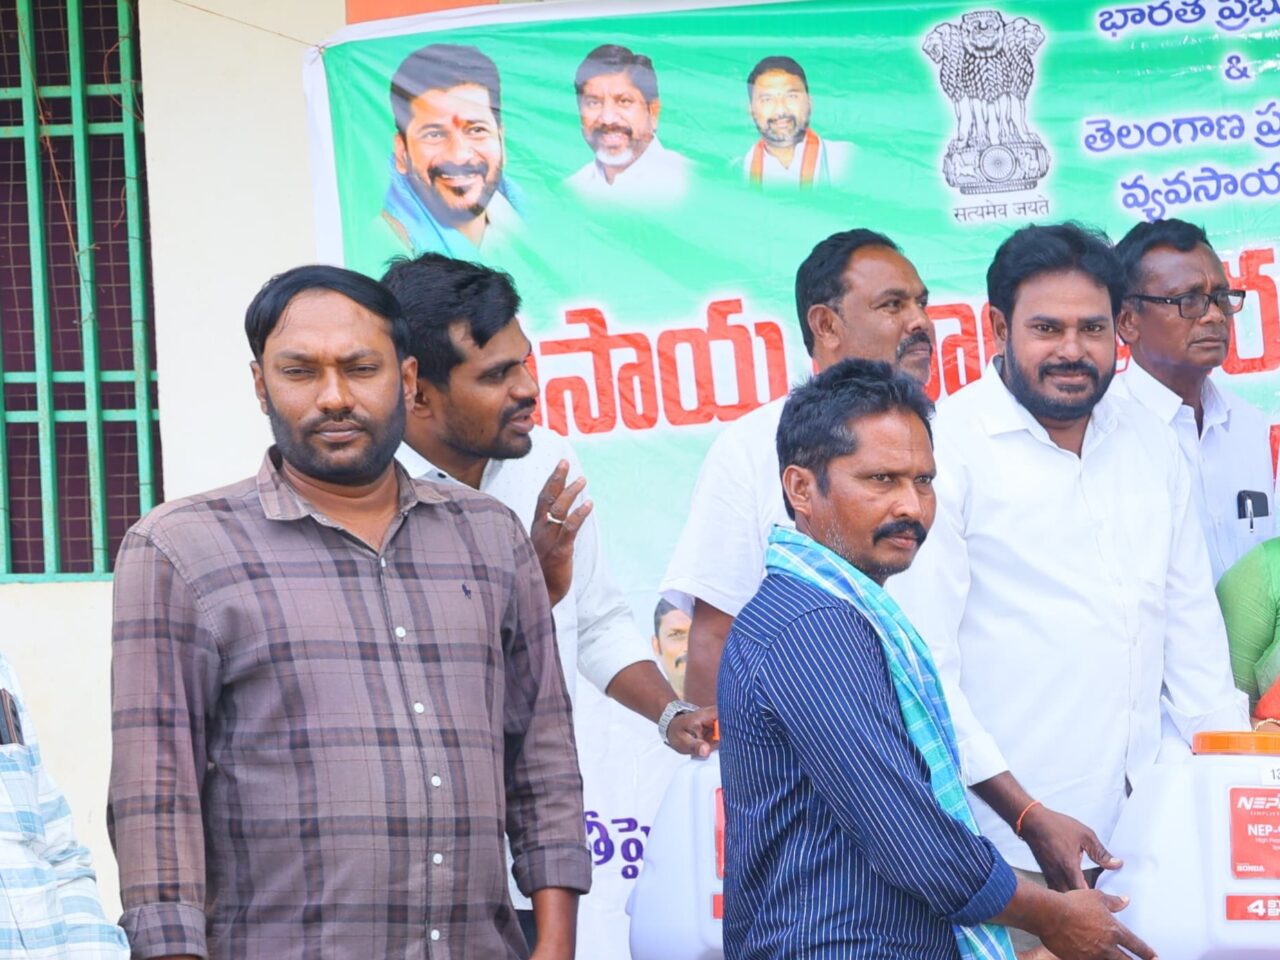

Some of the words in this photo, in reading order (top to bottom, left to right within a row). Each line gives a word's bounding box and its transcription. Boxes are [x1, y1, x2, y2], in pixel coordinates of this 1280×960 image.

[1224, 55, 1251, 80] &
[1084, 117, 1246, 153] తెలంగాణ
[953, 199, 1009, 223] सत्यमेव
[1012, 194, 1050, 217] जयते
[1247, 899, 1266, 917] 4
